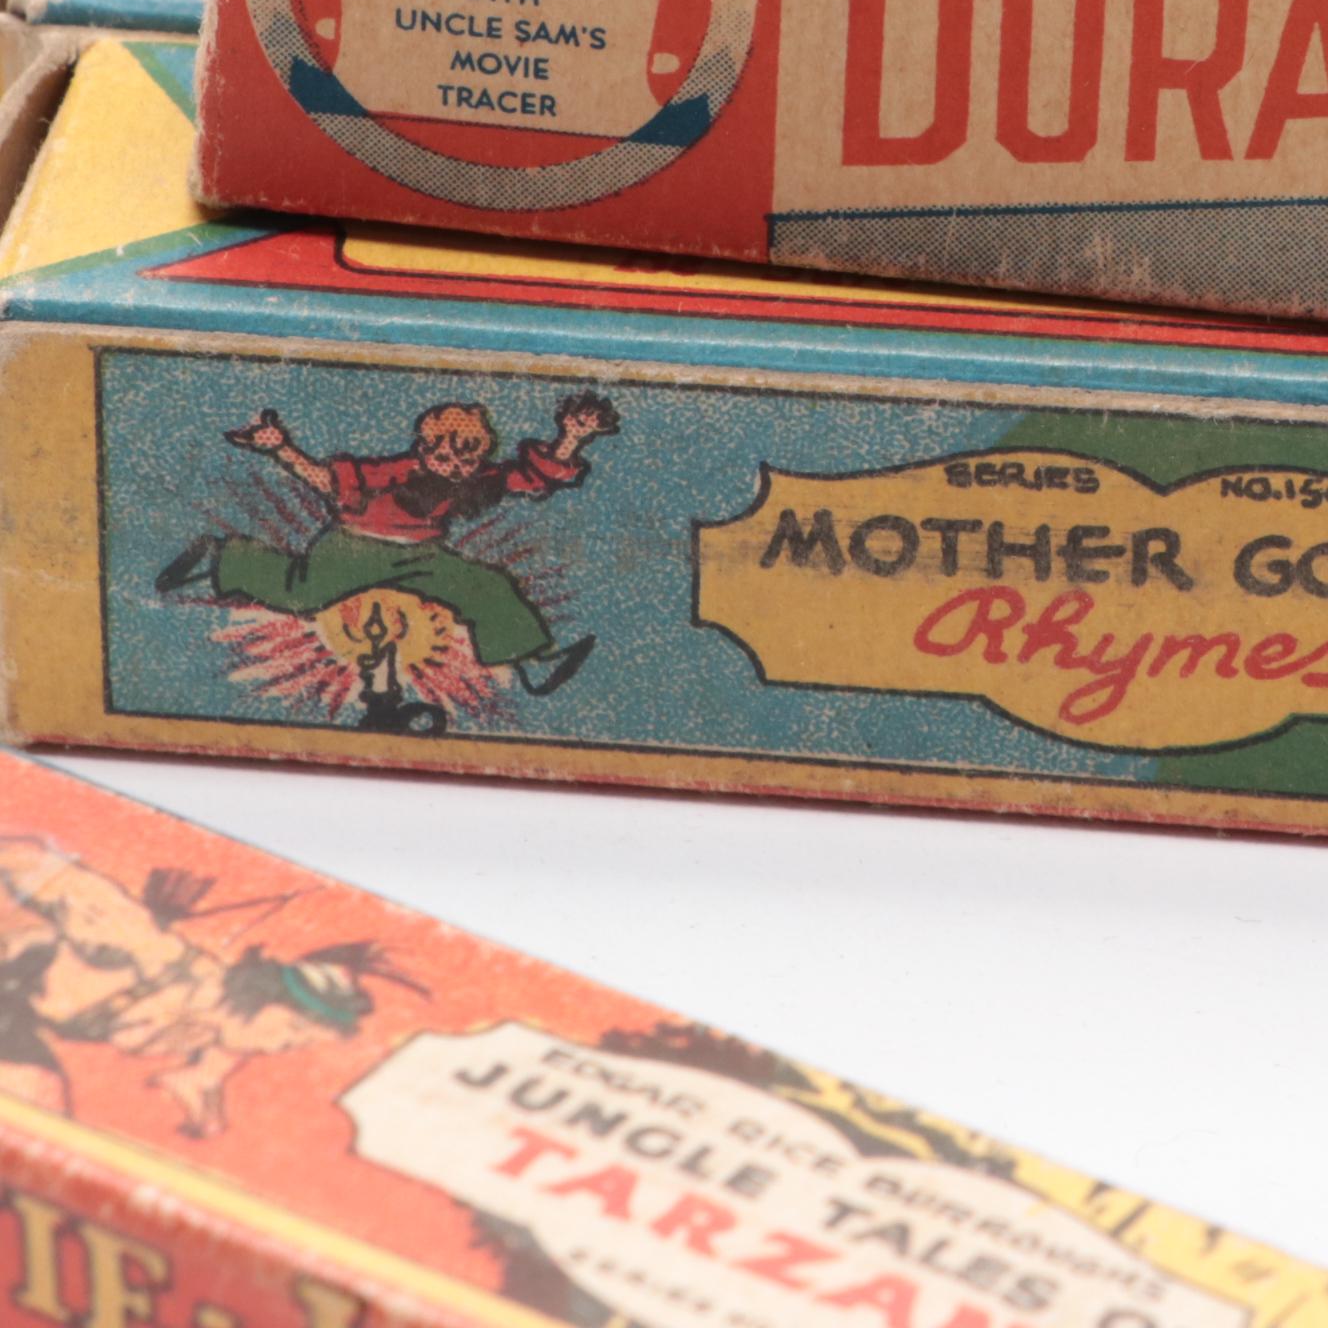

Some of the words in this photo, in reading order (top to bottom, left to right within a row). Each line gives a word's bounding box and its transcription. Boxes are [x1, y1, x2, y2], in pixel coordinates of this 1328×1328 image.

[395, 8, 503, 39] UNCLE
[514, 19, 607, 50] SAM'S
[450, 50, 550, 80] MOVIE
[437, 84, 557, 117] TRACER
[943, 460, 1101, 494] SERIES
[759, 507, 1196, 593] MOTHER
[541, 1048, 708, 1120] EDGAR
[728, 1118, 848, 1175] RICE
[453, 1059, 780, 1201] JUNGLE
[823, 1195, 1059, 1313] TALES
